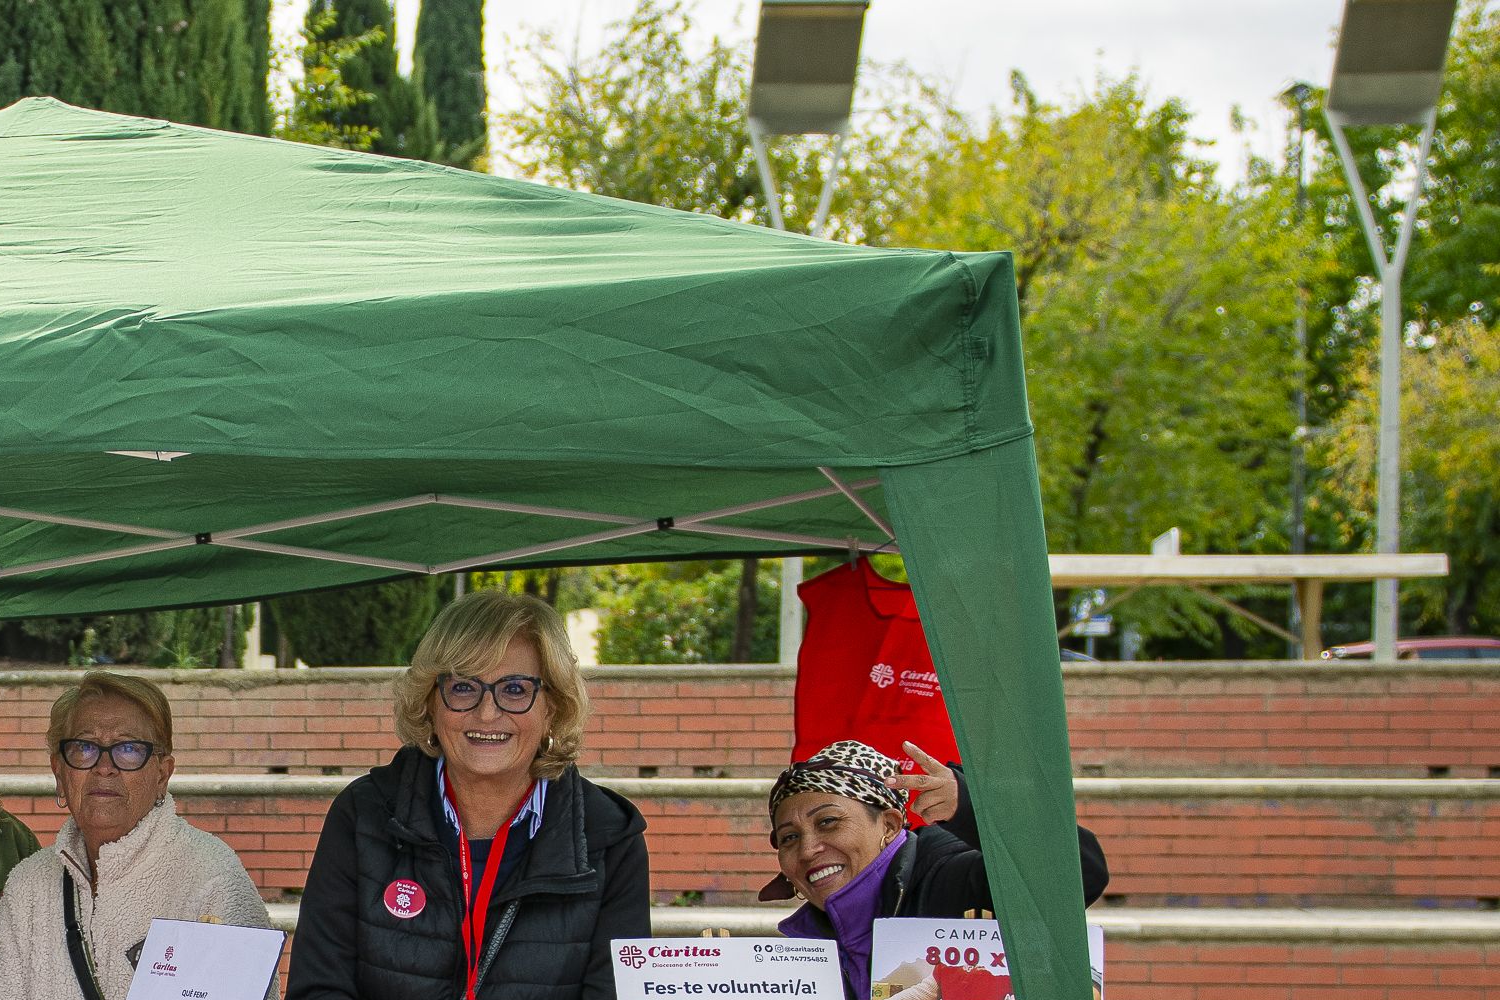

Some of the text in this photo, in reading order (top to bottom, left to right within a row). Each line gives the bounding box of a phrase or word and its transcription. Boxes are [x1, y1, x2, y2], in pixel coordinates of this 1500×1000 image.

[935, 929, 1001, 940] CAMPA
[648, 946, 721, 957] Càritas
[926, 946, 979, 966] 800
[153, 962, 177, 972] Càritas
[644, 979, 817, 996] Fes-te voluntari/a!
[182, 989, 208, 999] QUÈ FEM?
